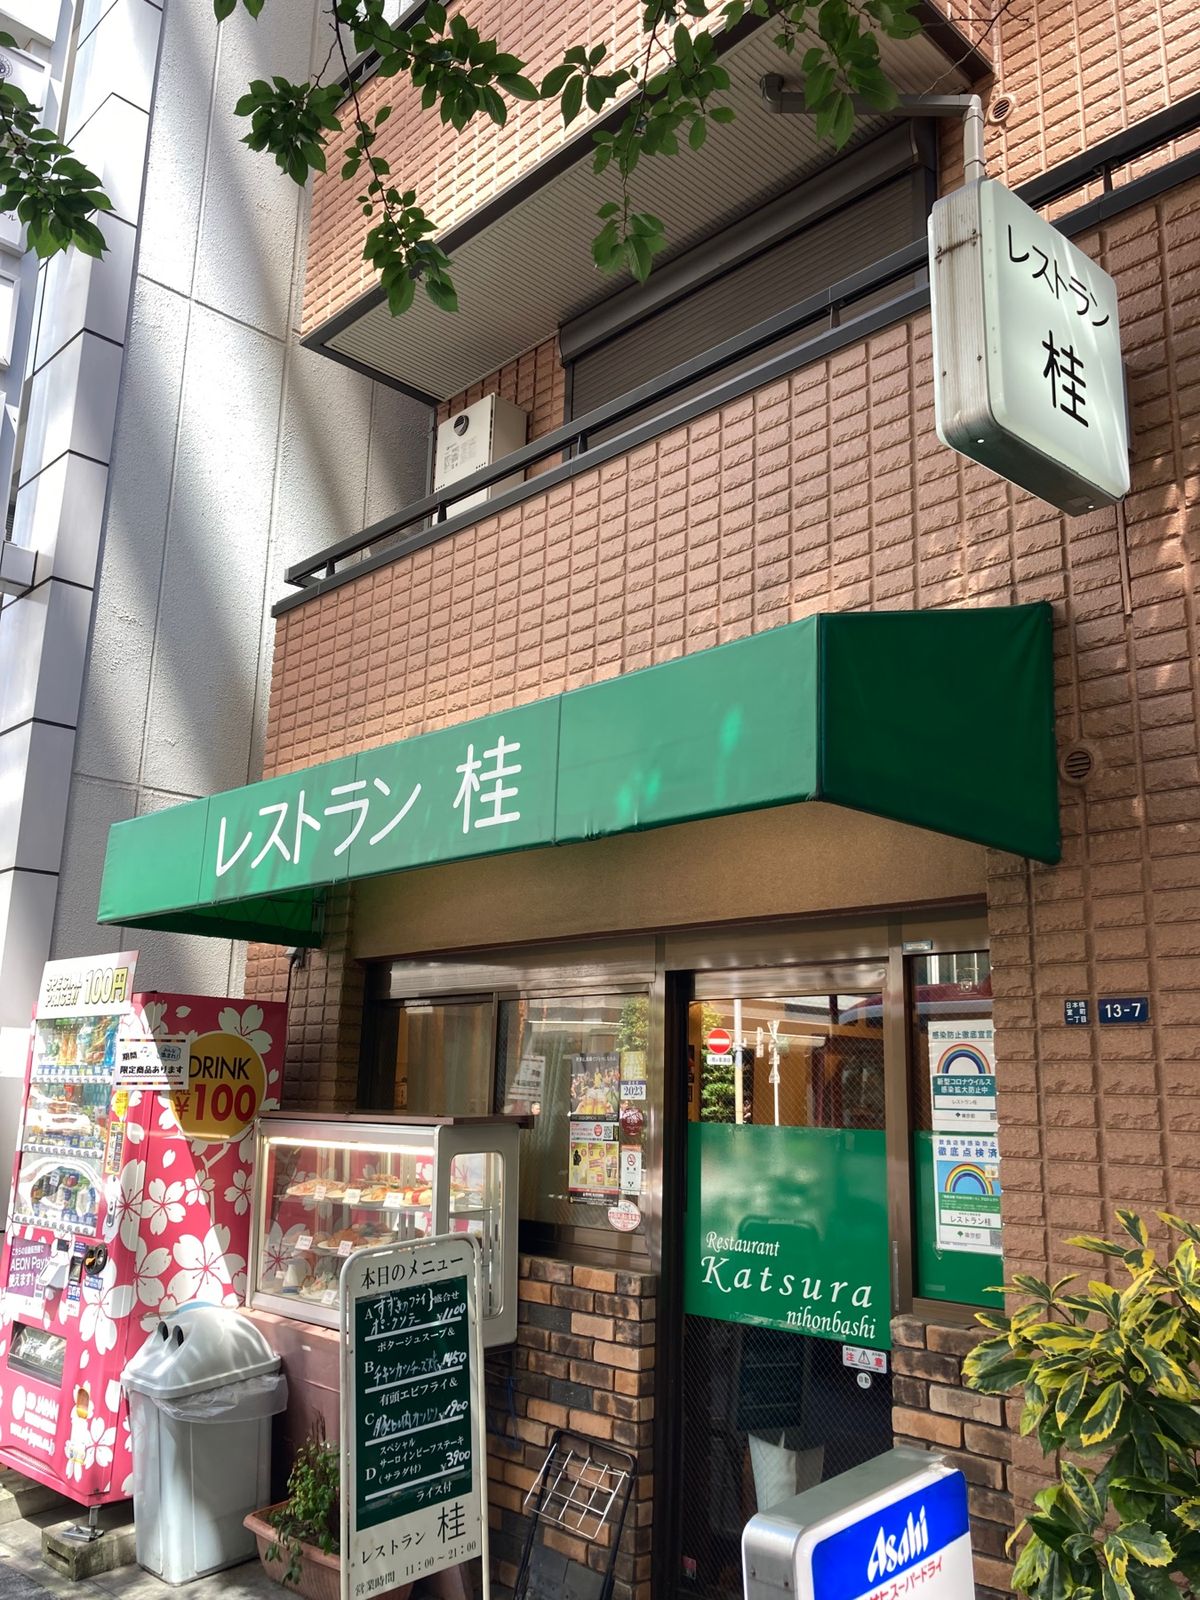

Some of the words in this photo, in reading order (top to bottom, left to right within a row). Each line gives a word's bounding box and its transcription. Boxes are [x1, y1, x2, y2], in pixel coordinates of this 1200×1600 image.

[1007, 224, 1110, 327] レストラン
[1042, 330, 1089, 428] 桂
[215, 778, 422, 878] レストラン
[453, 735, 522, 834] 桂
[84, 967, 128, 1005] 100円
[1105, 1003, 1141, 1018] 13-7
[932, 1030, 993, 1039] 感染防止徹底宣言
[122, 1051, 138, 1061] 期間
[120, 1065, 183, 1074] 限定商品あります
[189, 1055, 251, 1080] DRINK
[623, 1085, 643, 1096] 2023
[937, 1077, 992, 1086] 新型コロナウイルス
[941, 1086, 988, 1094] 感染拡大防止中
[938, 1146, 997, 1158] 徹底点検済
[950, 1215, 992, 1226] レストラン桂
[706, 1231, 780, 1256] Restaurant
[10, 1256, 30, 1271] AEON
[361, 1257, 464, 1290] 本日のメニュー
[701, 1256, 873, 1308] Katsura
[364, 1308, 373, 1320] A
[787, 1305, 876, 1339] nihonbashi
[364, 1361, 374, 1374] B
[364, 1413, 374, 1426] C
[380, 1438, 416, 1455] スペシャル
[380, 1435, 464, 1468] サーロインビーフステーキ
[365, 1467, 376, 1480] D
[416, 1480, 452, 1502] ライス付
[362, 1531, 426, 1564] レストラン
[437, 1502, 466, 1544] 桂
[867, 1505, 929, 1583] Asahi
[355, 1570, 396, 1597] 営業時間
[890, 1555, 943, 1600] スーパードライ
